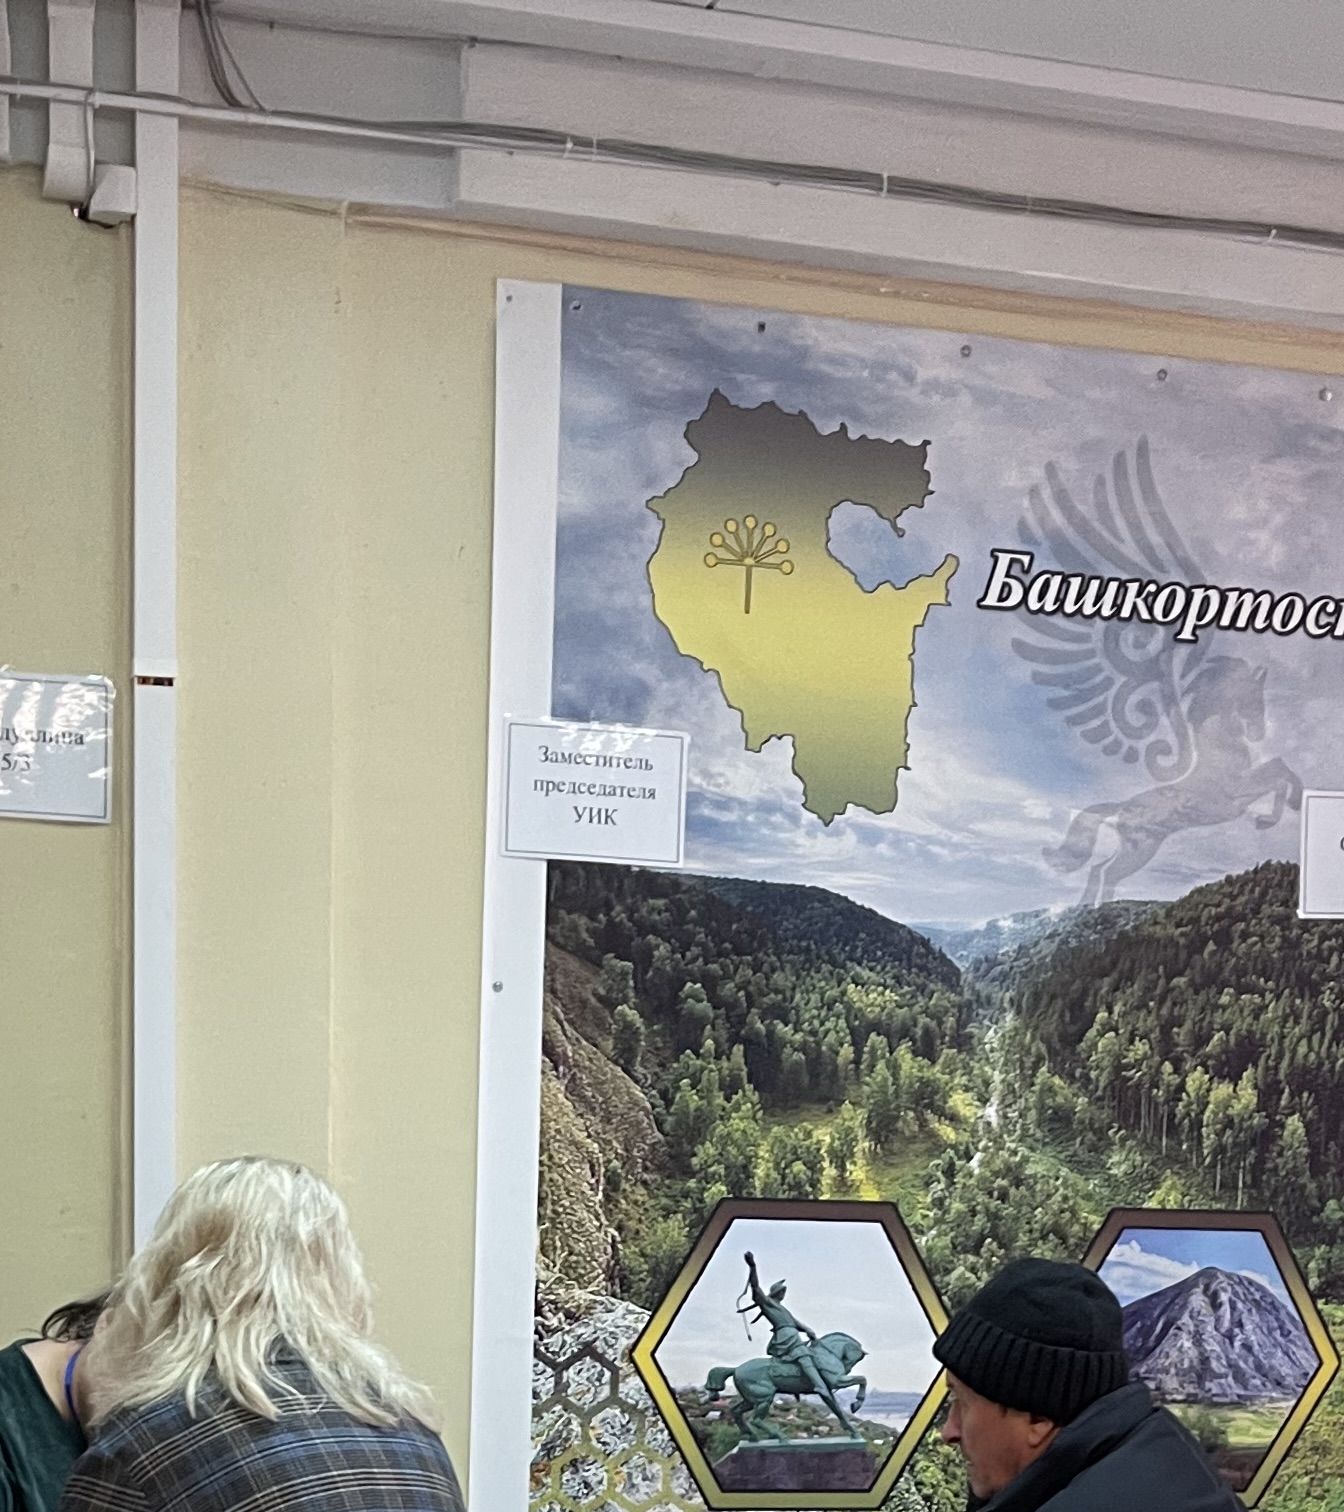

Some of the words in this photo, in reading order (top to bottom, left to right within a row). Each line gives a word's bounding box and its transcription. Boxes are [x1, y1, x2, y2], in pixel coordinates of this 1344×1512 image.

[538, 745, 654, 772] Заместитель
[533, 779, 657, 800] председателя
[572, 805, 618, 826] УИК
